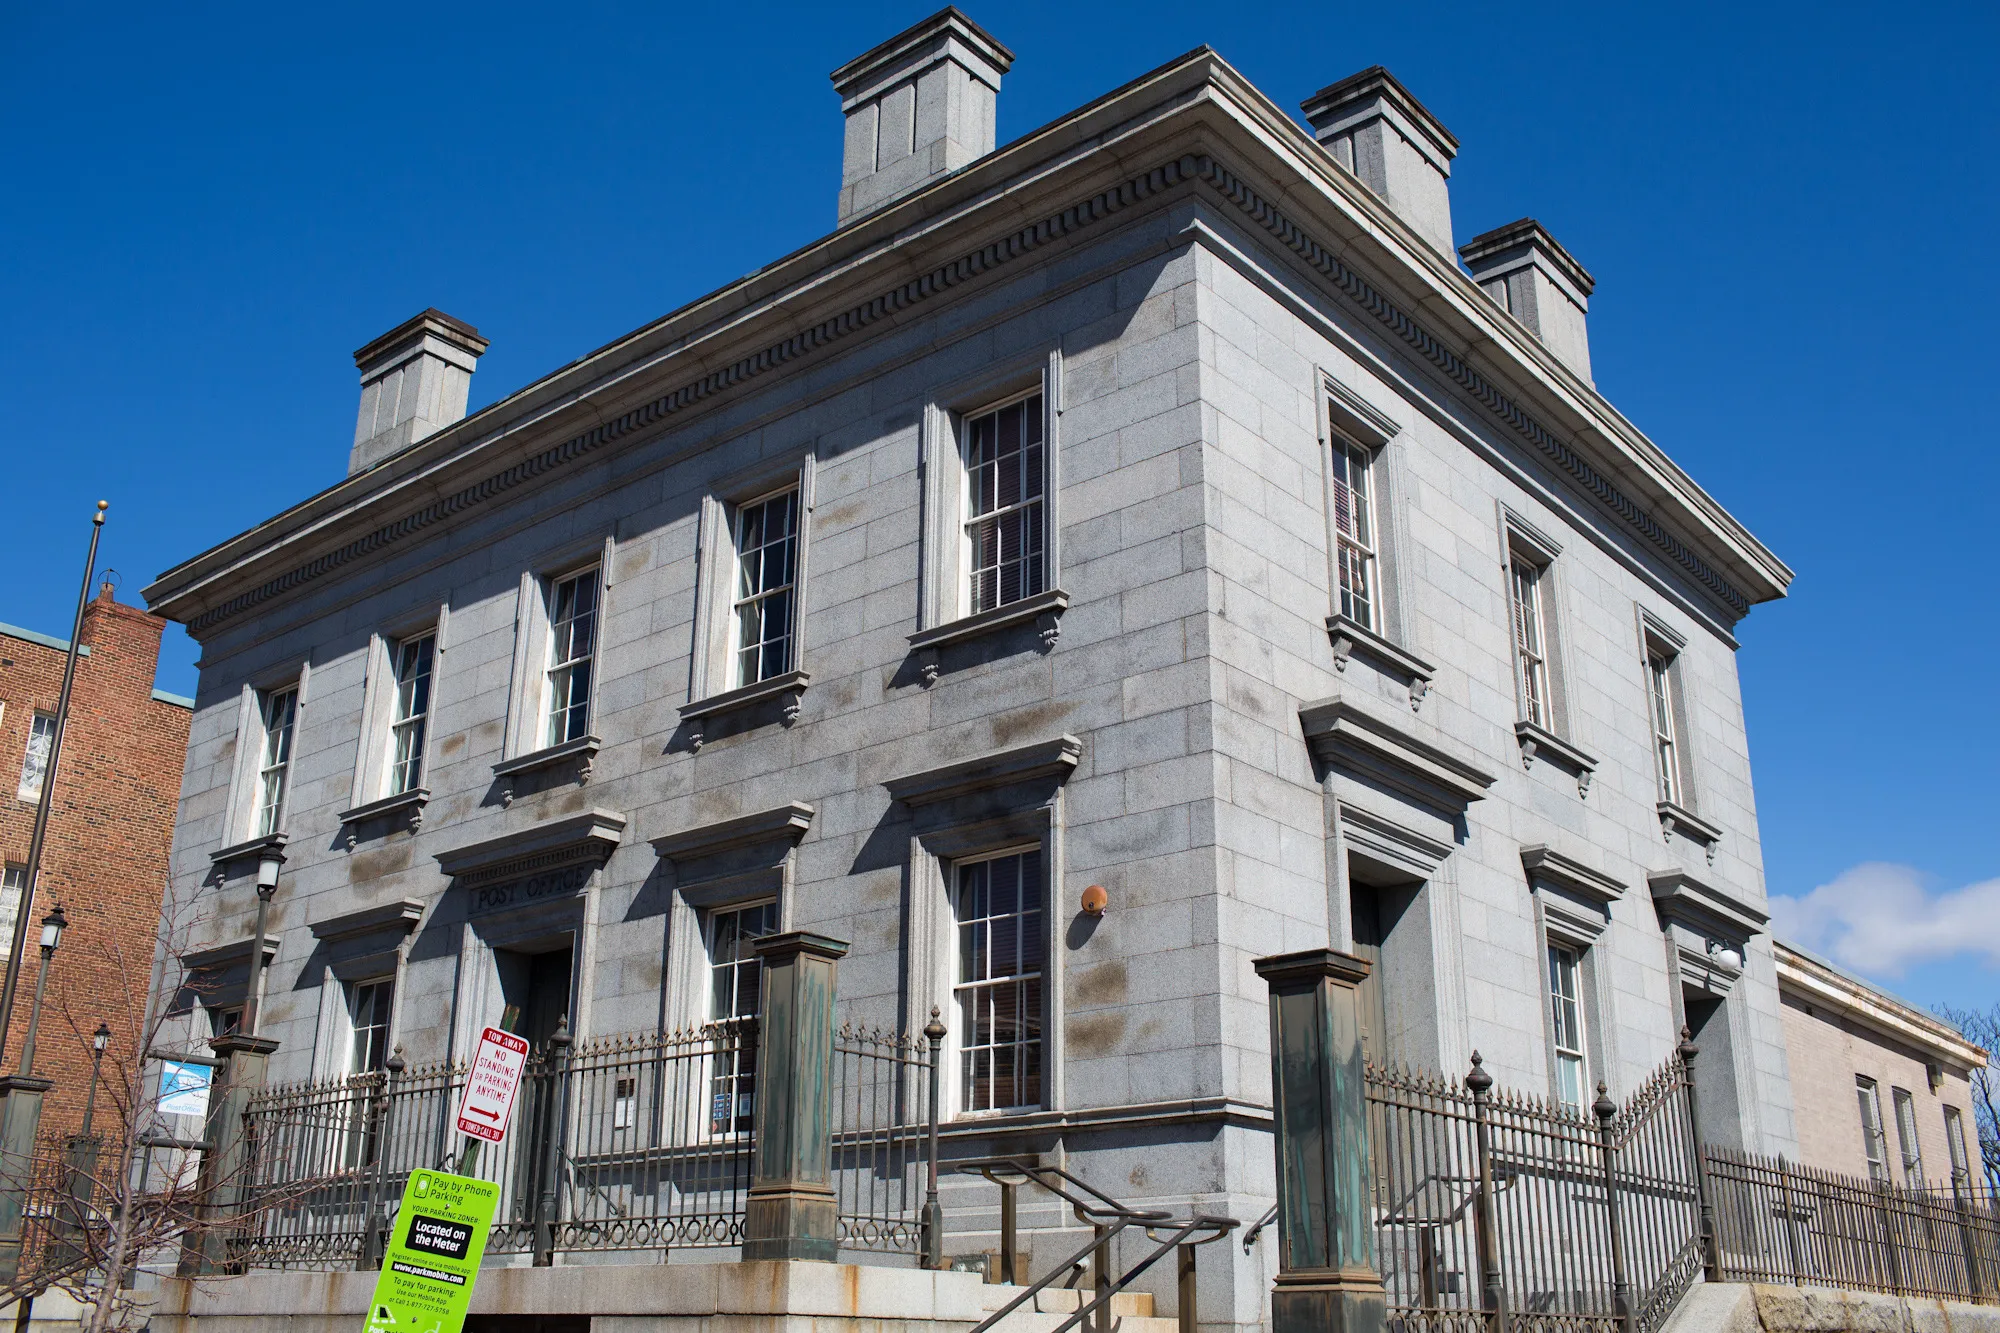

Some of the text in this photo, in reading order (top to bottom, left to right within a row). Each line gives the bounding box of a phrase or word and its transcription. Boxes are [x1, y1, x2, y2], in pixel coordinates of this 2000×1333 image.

[479, 867, 585, 909] POST OFFICE
[488, 1031, 523, 1051] TOW AWAY
[495, 1049, 507, 1061] NO
[479, 1058, 515, 1078] STANDING
[475, 1072, 512, 1091] OR PARKING
[476, 1085, 507, 1103] ANYTIME
[459, 1120, 500, 1140] IF TOWED CALL 311
[430, 1189, 463, 1206] Parking
[434, 1178, 492, 1198] Pay by Phone
[412, 1204, 428, 1213] YOUR
[429, 1208, 456, 1220] PARKING
[416, 1220, 466, 1240] Located on
[415, 1233, 460, 1252] the Meter
[391, 1252, 412, 1261] Register
[412, 1257, 428, 1265] online
[443, 1263, 460, 1272] mobile
[393, 1263, 464, 1284] www.parkmobile.com
[393, 1276, 457, 1298] To pay for parking:
[395, 1297, 406, 1305] Call
[418, 1293, 436, 1302] Mobile
[436, 1297, 447, 1305] App
